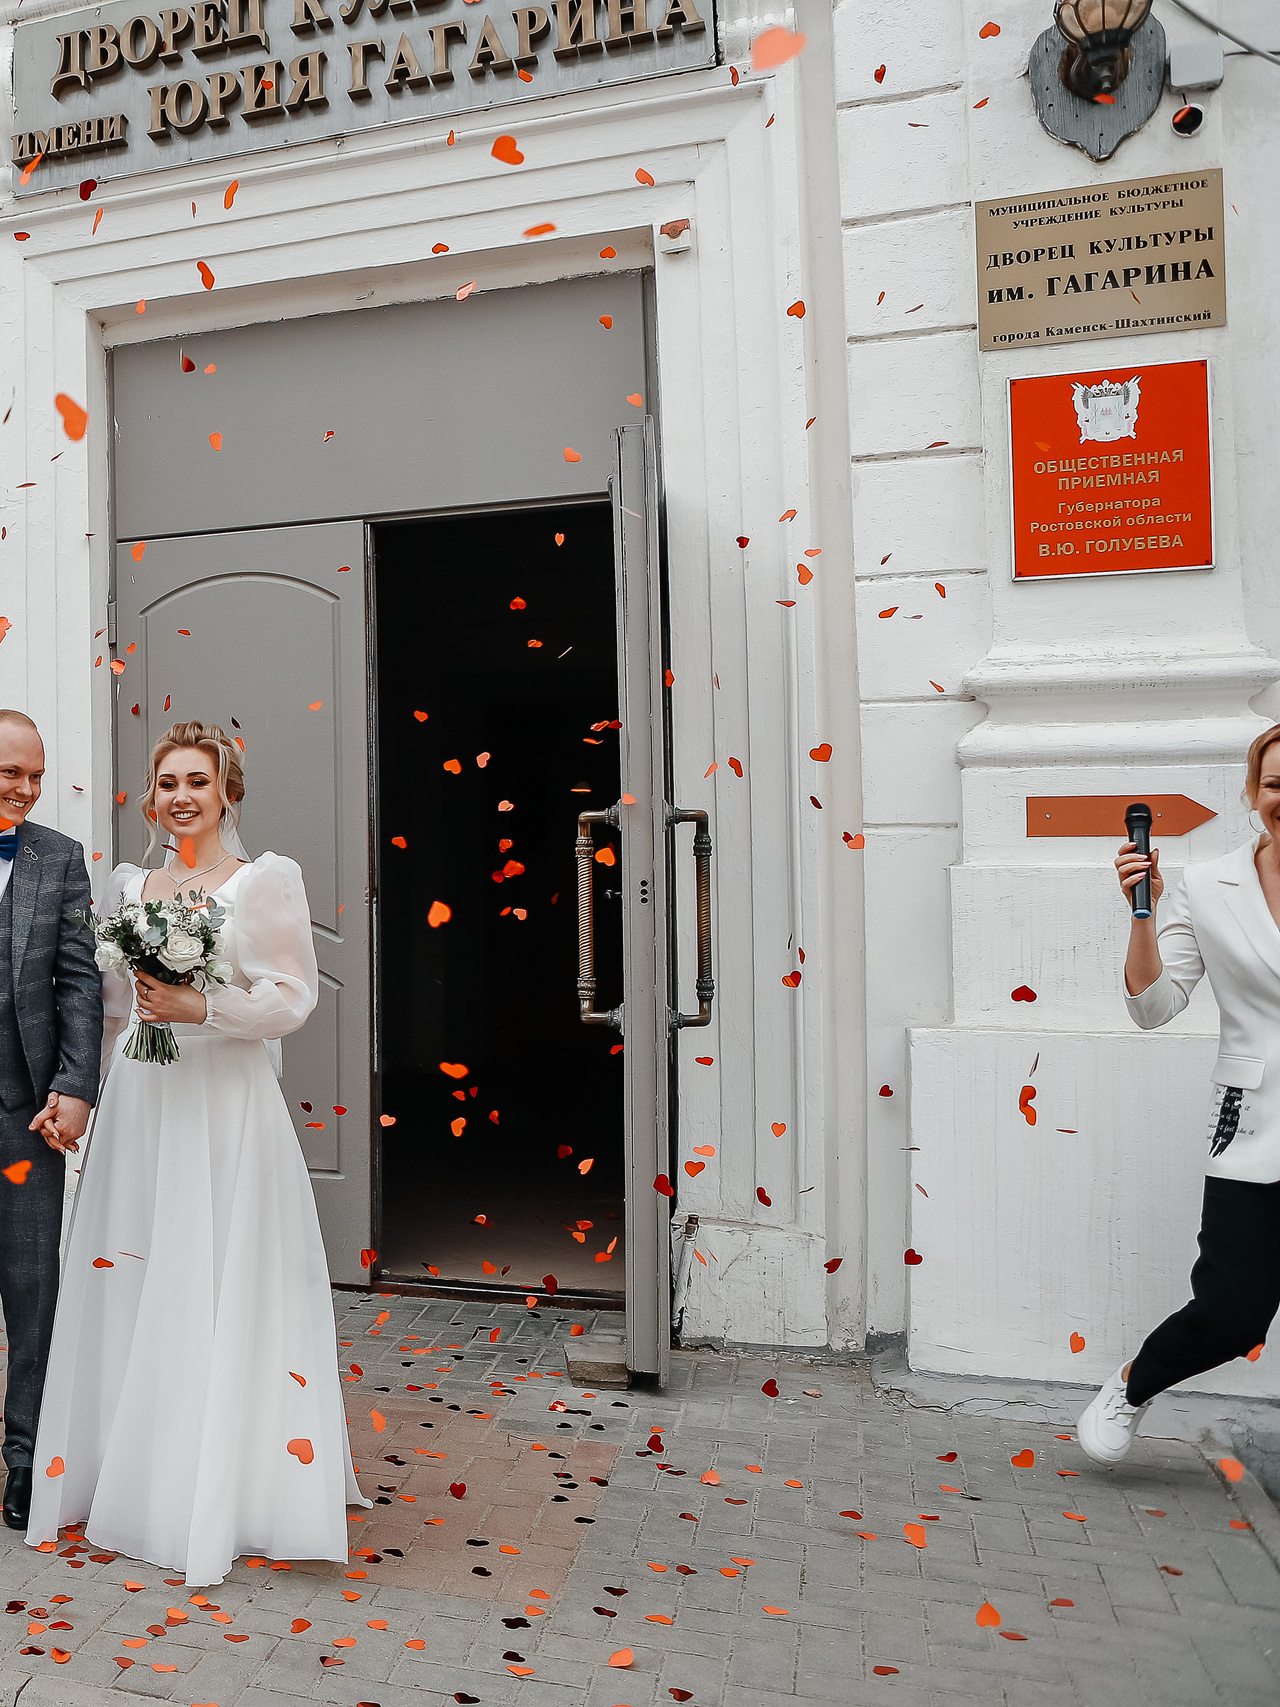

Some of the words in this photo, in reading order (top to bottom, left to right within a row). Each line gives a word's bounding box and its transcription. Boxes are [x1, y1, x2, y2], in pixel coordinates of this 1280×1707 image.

[50, 0, 270, 101] ДВОРЕЦ
[10, 113, 129, 166] ИМЕНИ
[147, 50, 328, 141] ЮРИЯ
[347, 0, 706, 99] ГАГАРИНА
[988, 192, 1110, 218] МУНИЦИПАЛЬНОЕ
[1117, 178, 1209, 200] БЮДЖЕТНОЕ
[1012, 209, 1102, 230] УЧРЕЖДЕНИЕ
[1109, 198, 1184, 217] КУЛЬТУРЫ
[986, 243, 1076, 271] ДВОРЕЦ
[1088, 226, 1215, 256] КУЛЬТУРЫ
[1046, 258, 1216, 297] ГАГАРИНА
[992, 329, 1041, 344] города
[1045, 309, 1212, 338] Каменск-Шахтинский
[1033, 449, 1185, 475] ОБЩЕСТВЕННАЯ
[1058, 470, 1160, 491] ПРИЕМНАЯ
[1030, 515, 1122, 534] Ростовской
[1126, 512, 1193, 528] области
[1057, 497, 1162, 517] Губернатора
[1038, 542, 1080, 557] В.Ю.
[1085, 534, 1184, 554] ГОЛУБЕВА
